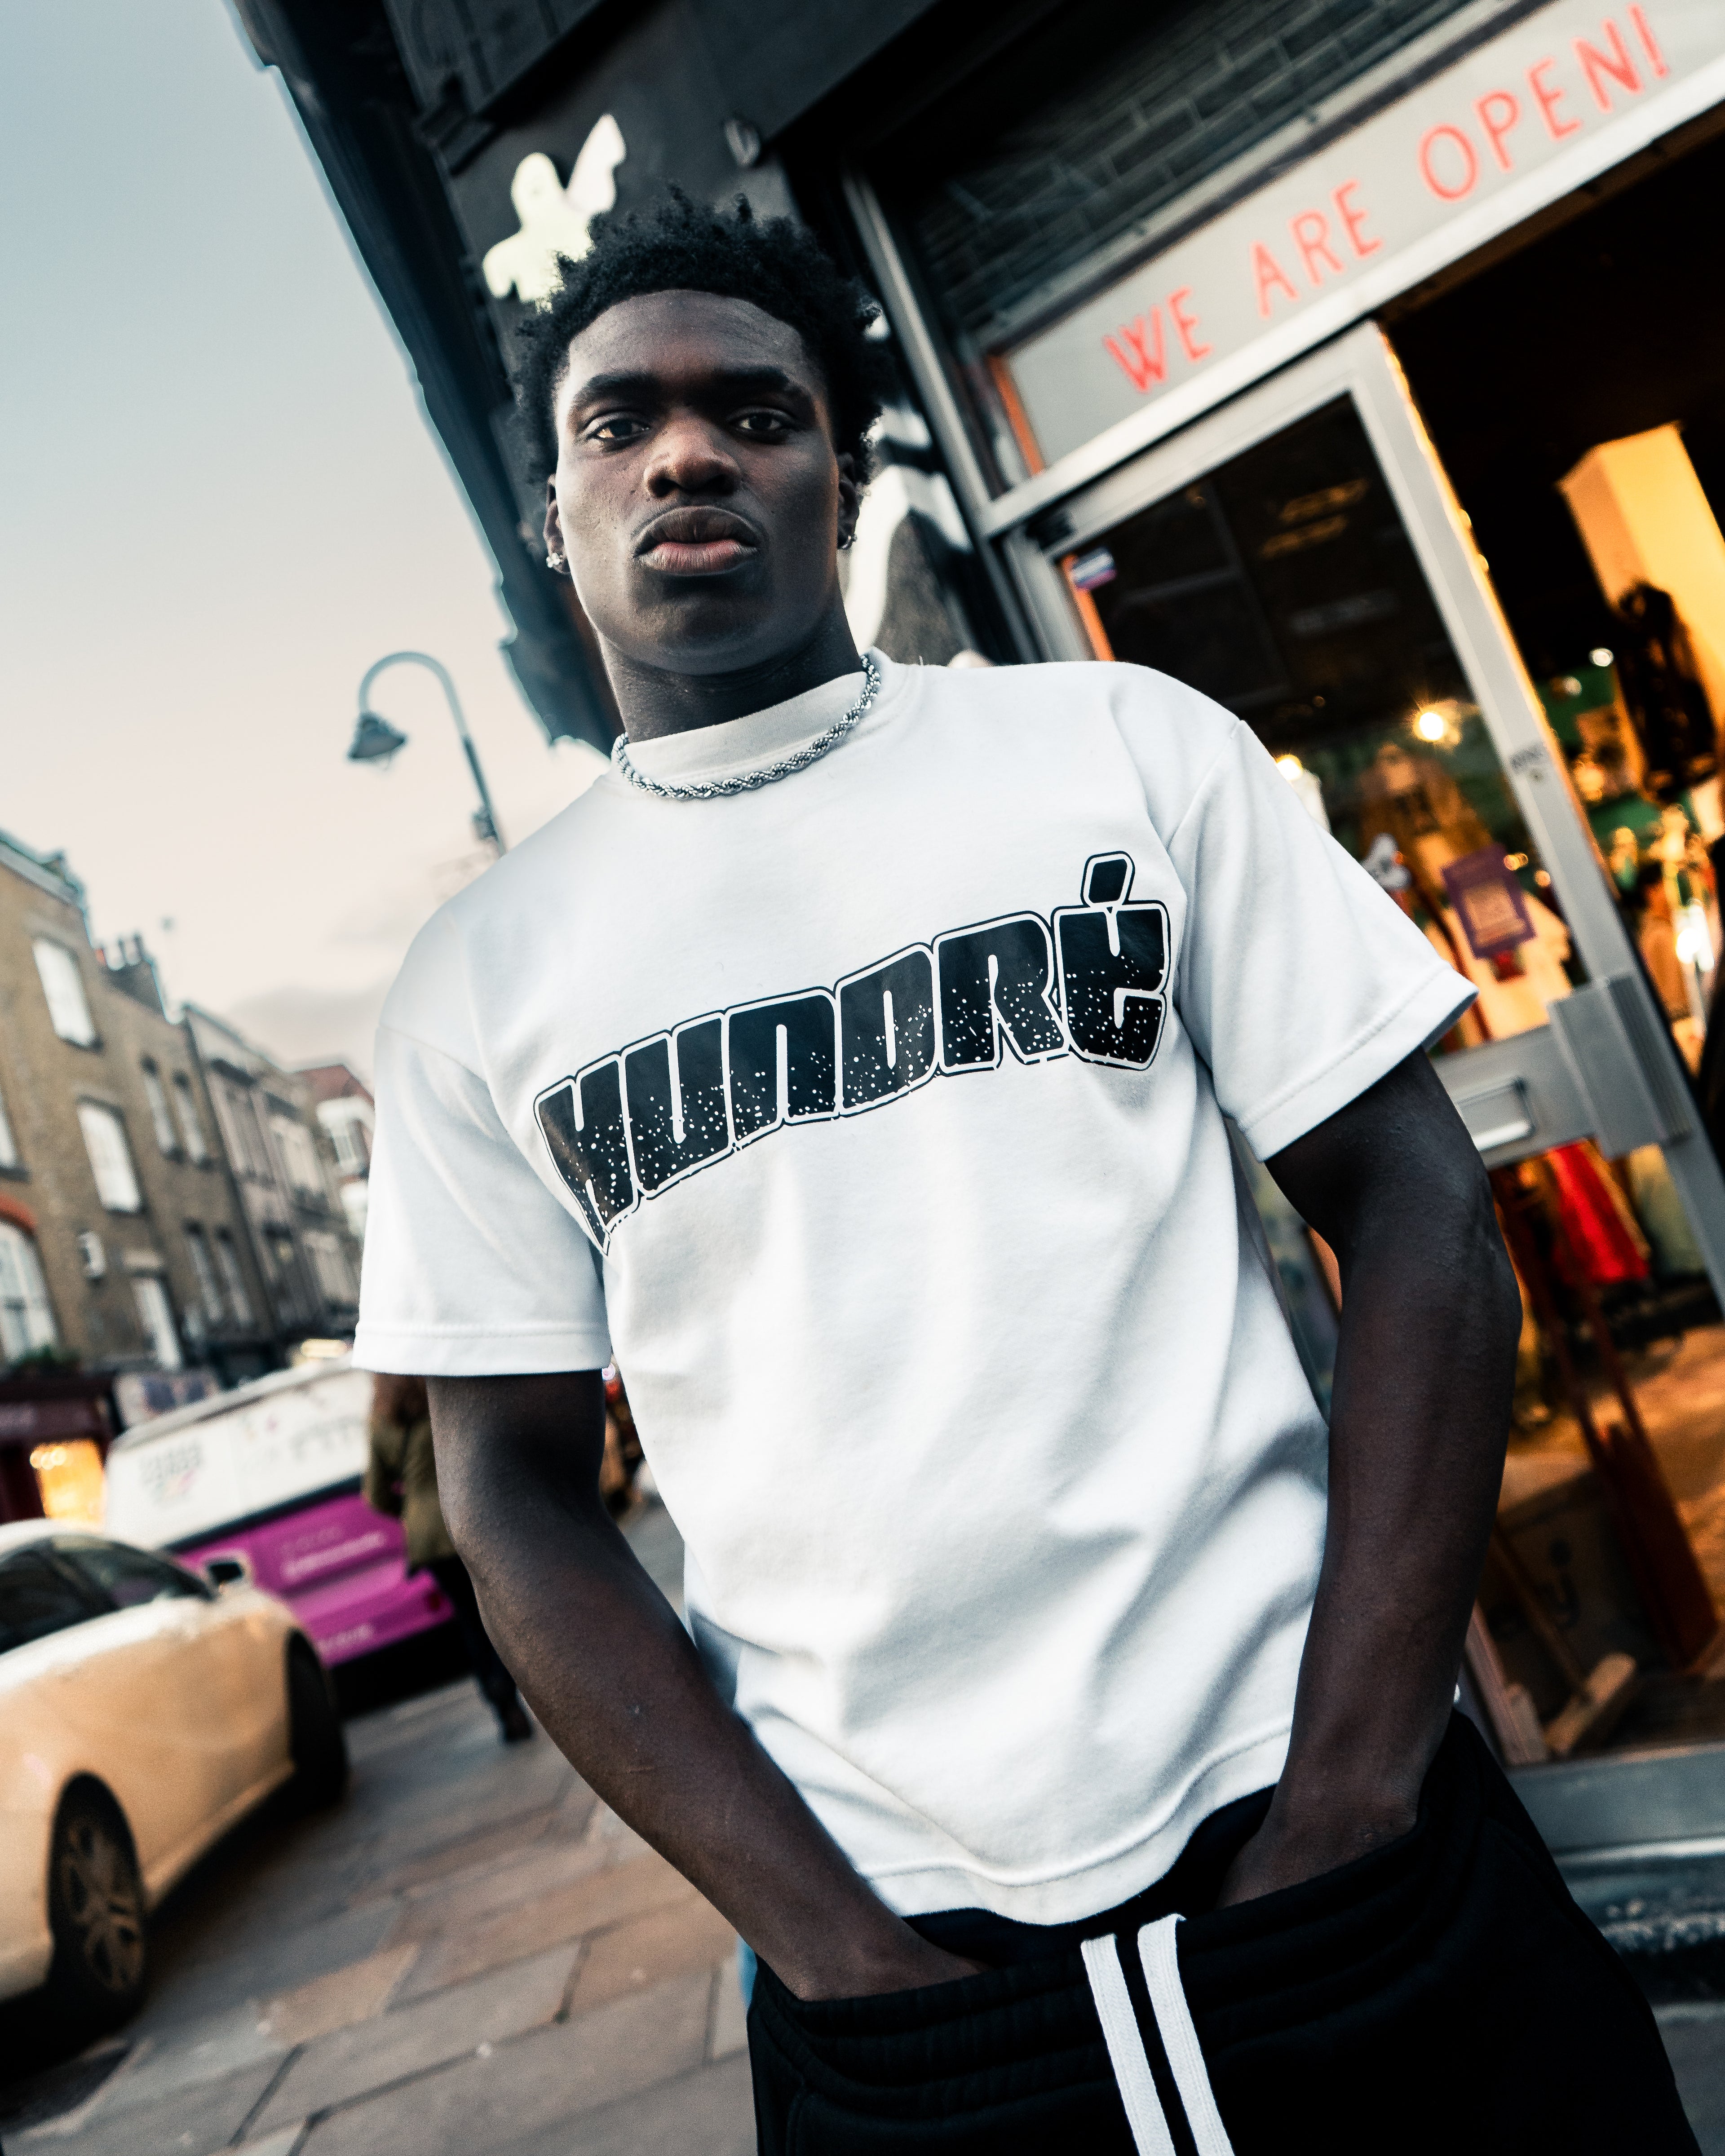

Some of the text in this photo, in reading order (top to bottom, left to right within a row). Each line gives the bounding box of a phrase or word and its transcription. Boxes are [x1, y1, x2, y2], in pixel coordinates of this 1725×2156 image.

[1104, 3, 1669, 394] WE ARE OPEN!
